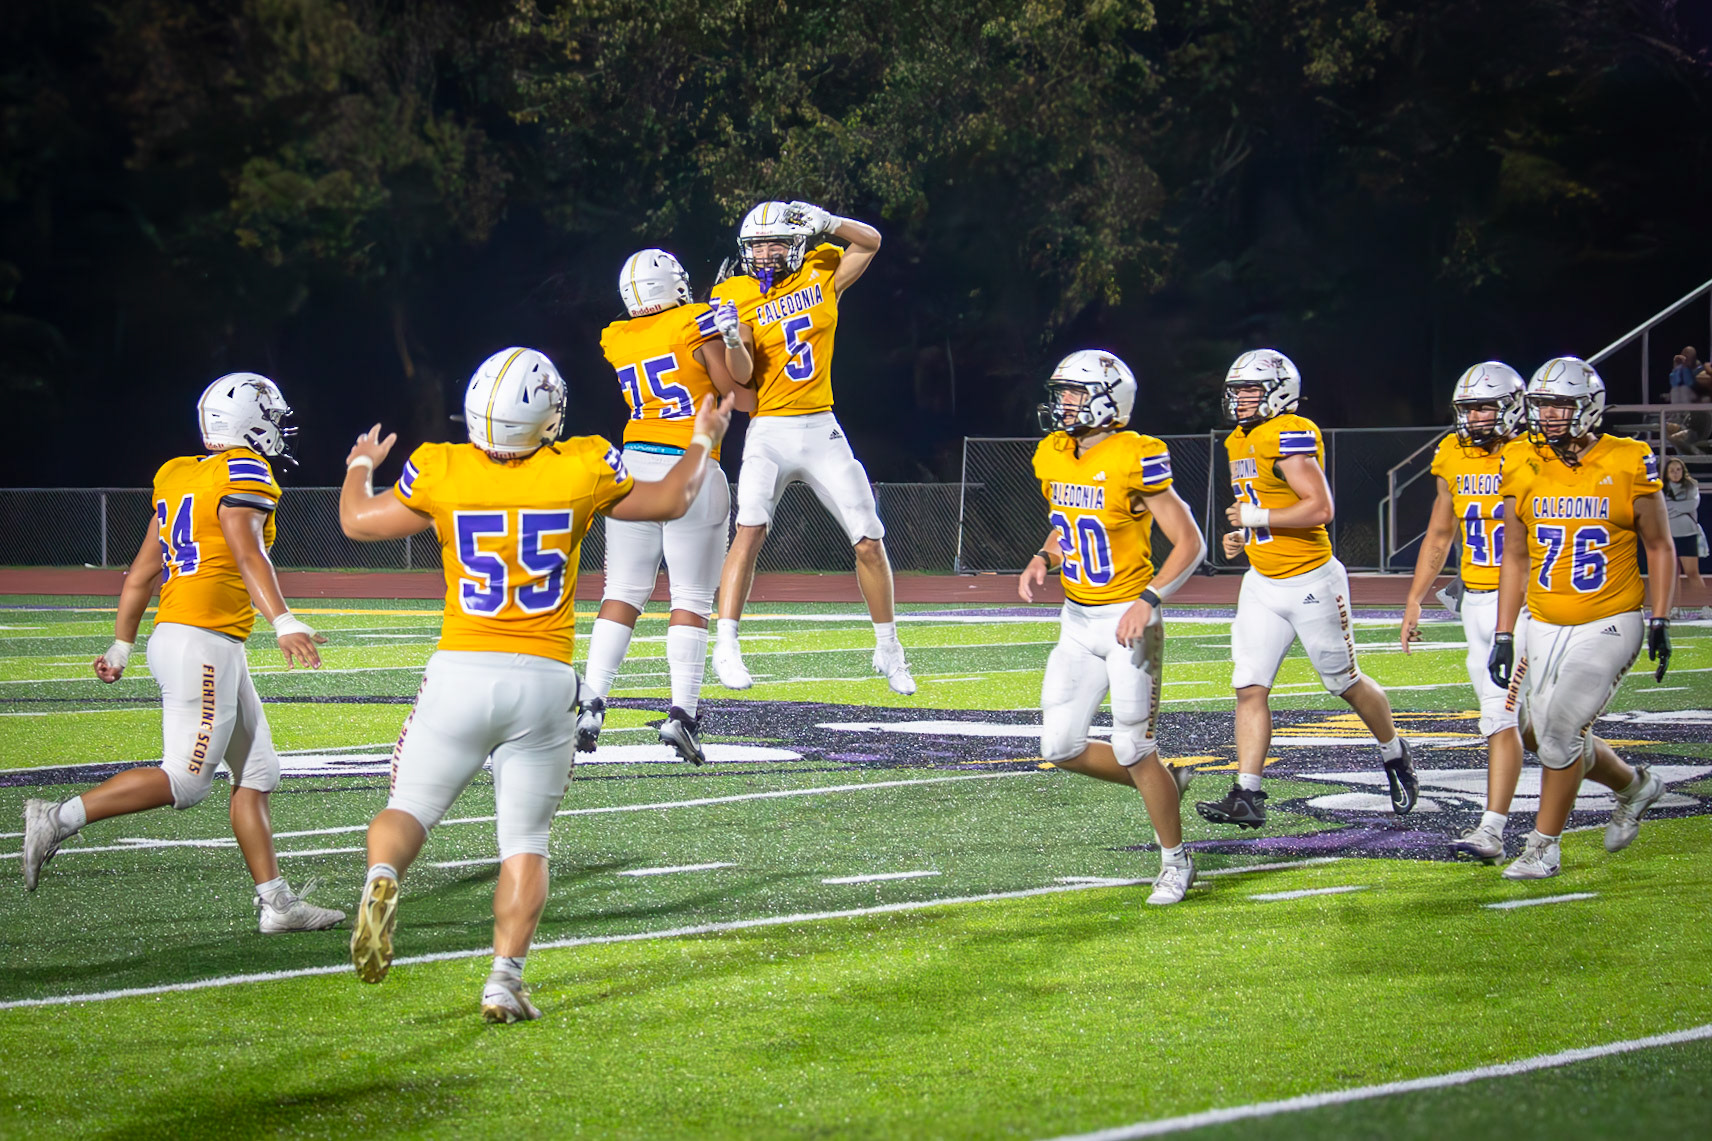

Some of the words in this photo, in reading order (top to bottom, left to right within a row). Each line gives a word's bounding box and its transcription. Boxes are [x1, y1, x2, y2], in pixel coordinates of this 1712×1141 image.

[756, 283, 823, 326] CALEDONIA
[780, 313, 815, 382] 5
[615, 352, 696, 420] 75
[1456, 473, 1501, 495] CALEDO
[1533, 496, 1610, 520] CALEDONIA
[453, 508, 574, 617] 55
[1049, 510, 1115, 587] 20
[1536, 523, 1611, 594] 76
[202, 664, 216, 732] FIGHTING
[1505, 656, 1529, 713] FIGHTING
[188, 732, 211, 775] SCOTS
